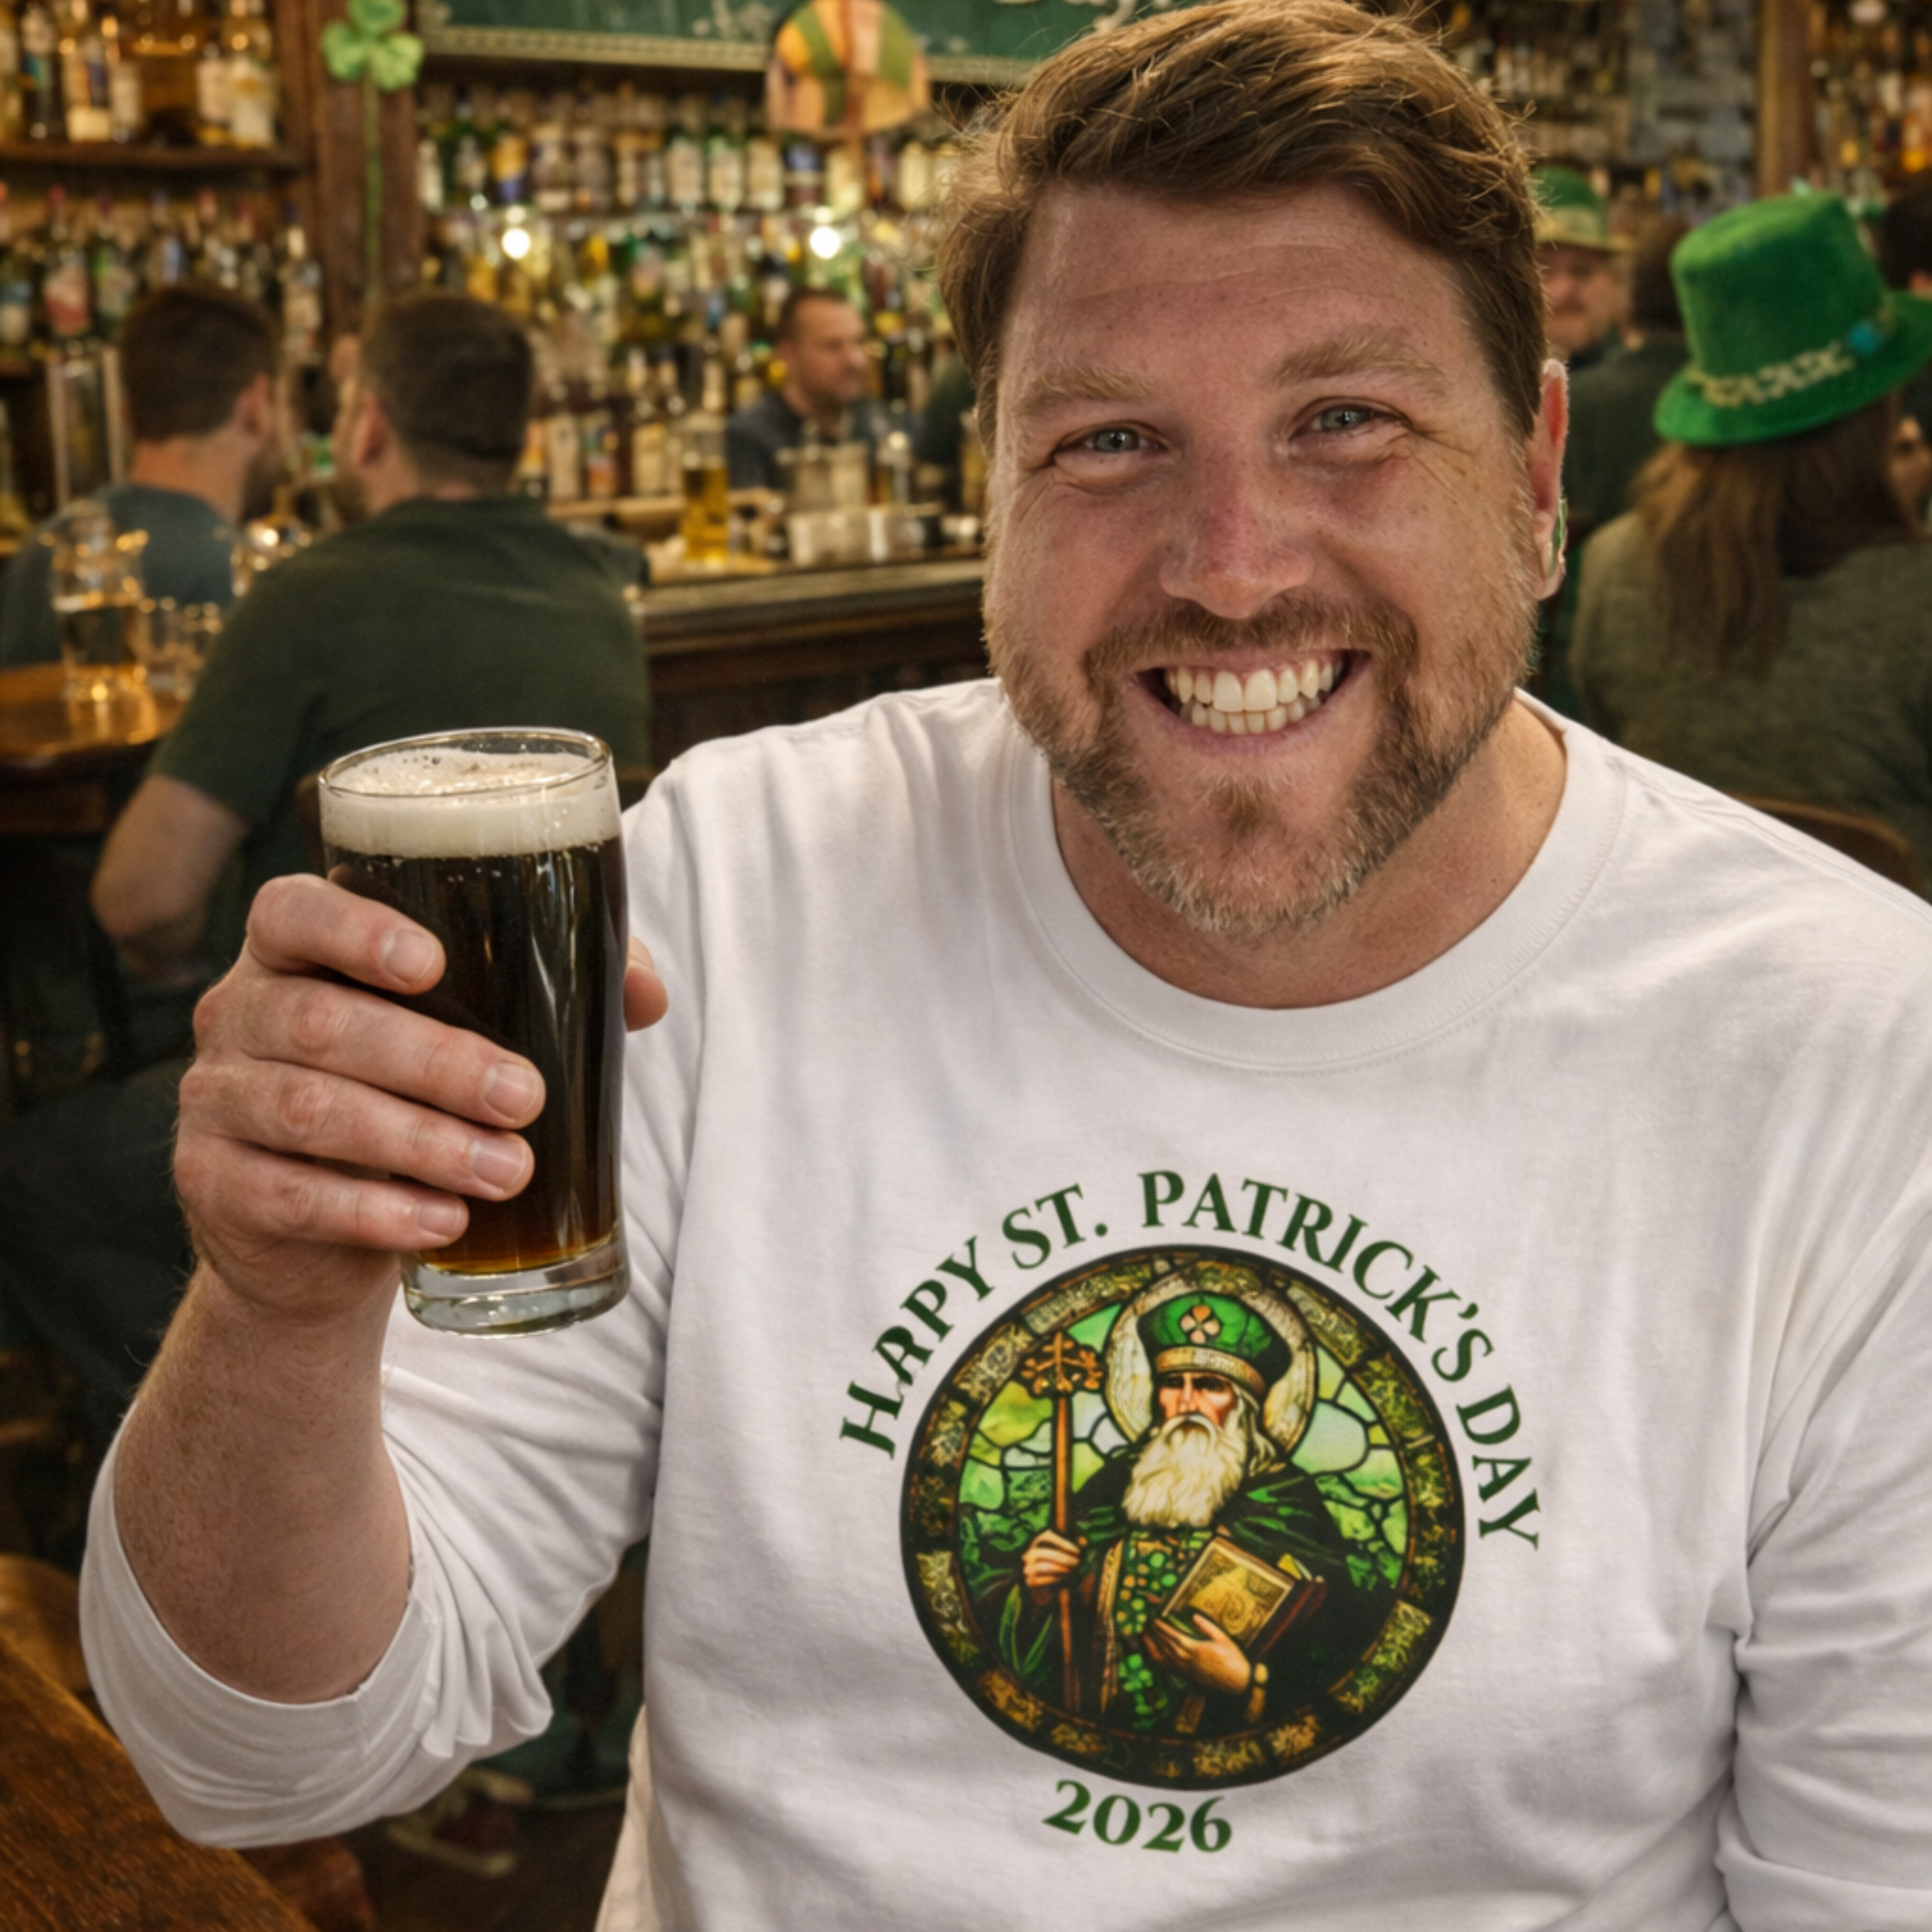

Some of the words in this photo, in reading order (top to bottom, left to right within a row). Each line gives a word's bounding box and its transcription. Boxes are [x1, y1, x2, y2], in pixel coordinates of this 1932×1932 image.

[1002, 1183, 1108, 1270] ST.
[1137, 1170, 1494, 1382] PATRICK'S
[1455, 1385, 1541, 1550] DAY
[1041, 1780, 1232, 1852] 2026
